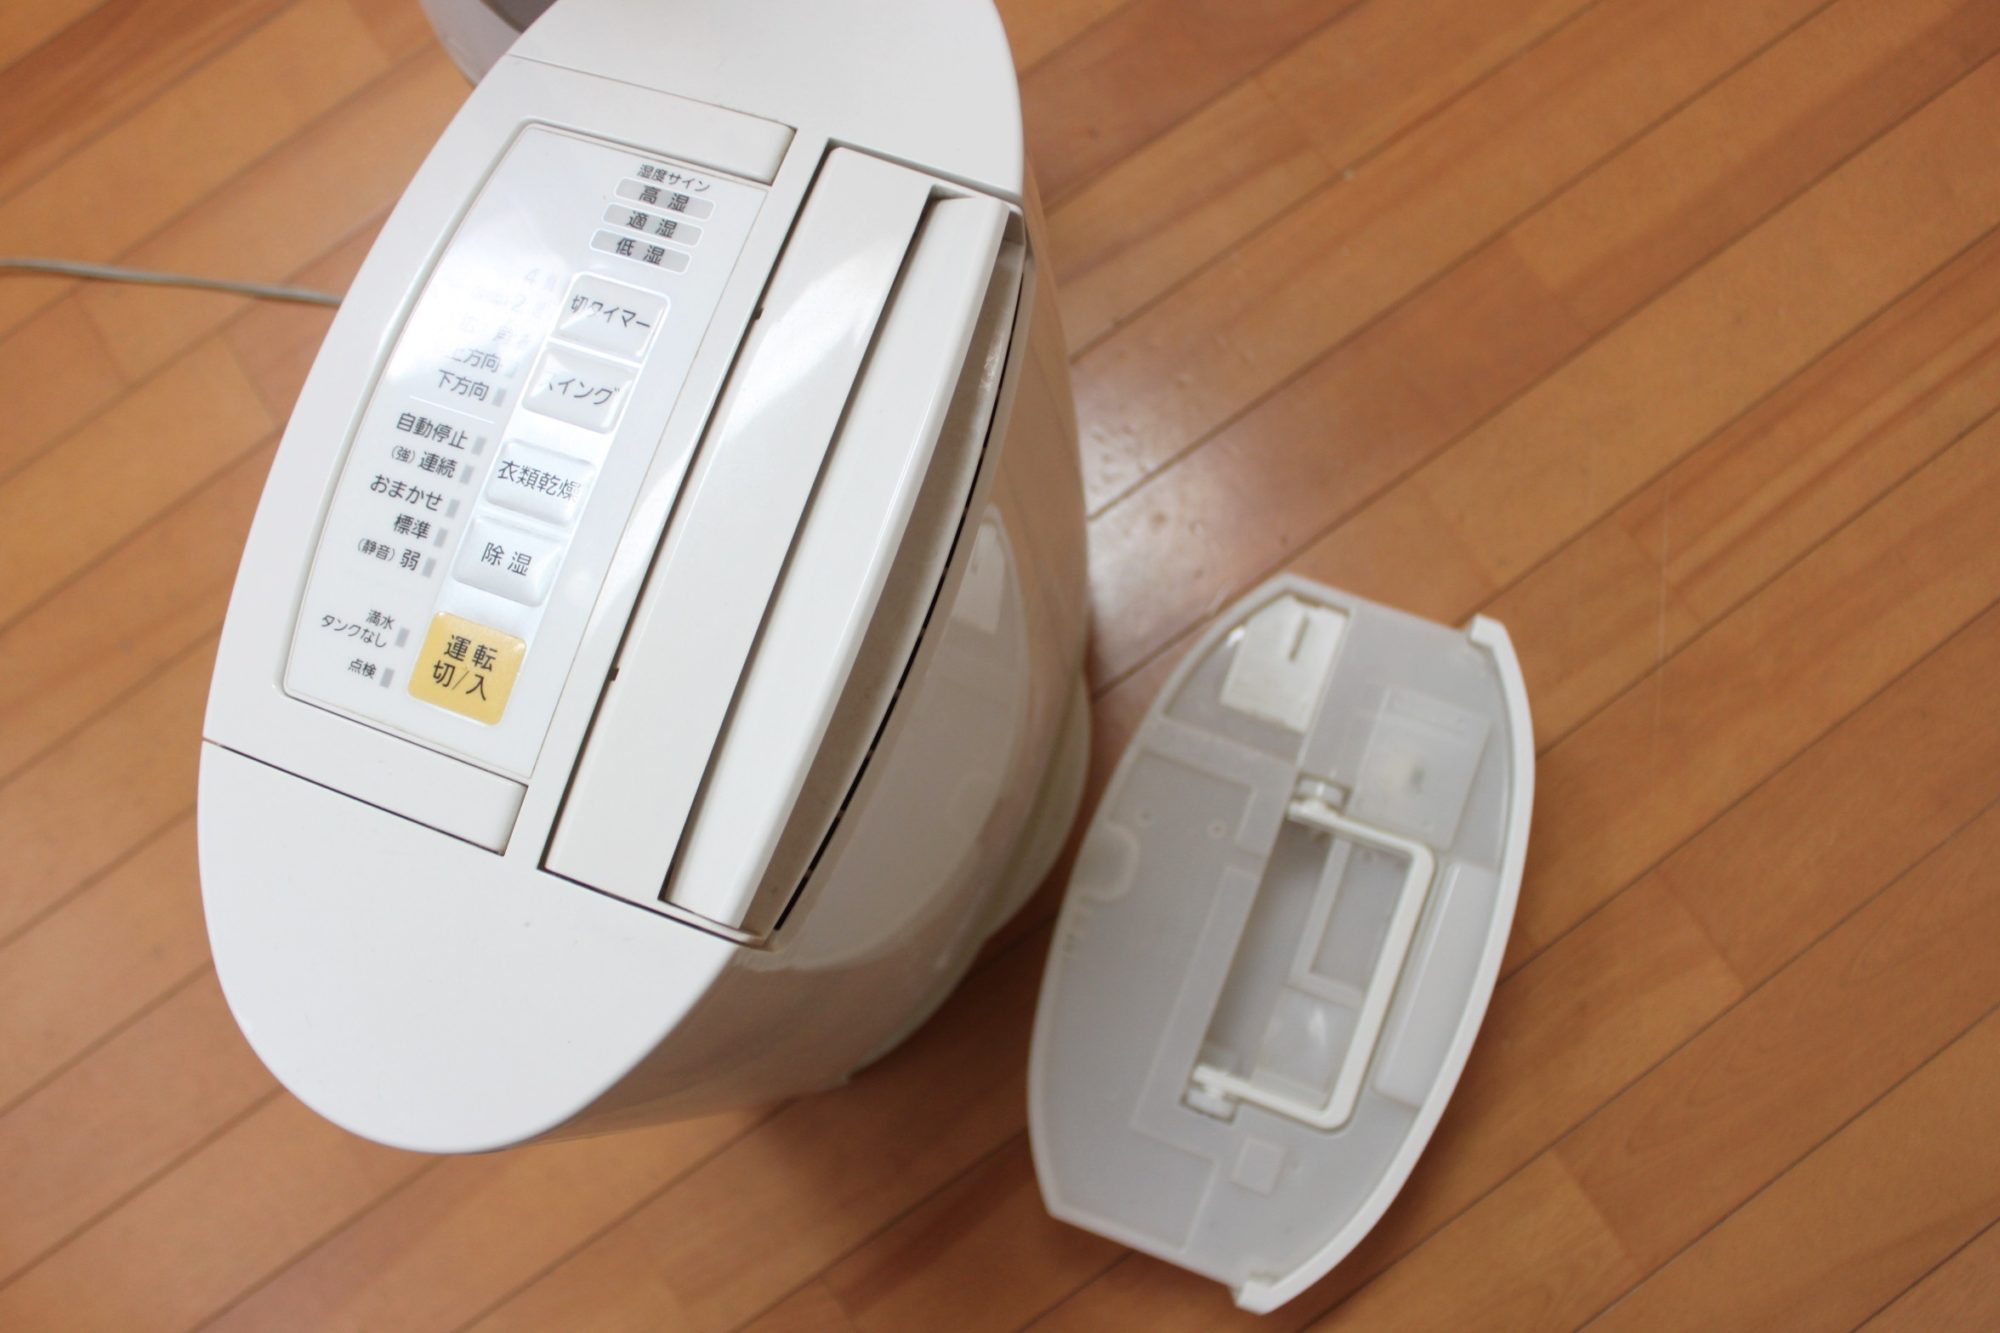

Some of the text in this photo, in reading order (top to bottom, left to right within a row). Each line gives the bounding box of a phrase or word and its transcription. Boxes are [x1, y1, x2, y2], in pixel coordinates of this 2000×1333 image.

[636, 163, 710, 193] 湿度サイン
[639, 185, 690, 213] 高湿
[626, 210, 678, 239] 適湿
[615, 237, 666, 265] 低湿
[570, 294, 652, 329] 切タイマー
[437, 368, 490, 402] 下方向
[547, 378, 621, 406] イング
[395, 412, 469, 451] 自動停止
[370, 474, 443, 513] おまかせ
[497, 460, 582, 504] 衣類乾燥
[393, 513, 432, 541] 標準
[481, 541, 532, 577] 除湿
[320, 614, 388, 648] タンクなし
[365, 609, 396, 630] 満水
[348, 658, 378, 679] 点検
[444, 634, 499, 672] 運転
[432, 660, 487, 701] 切/入
